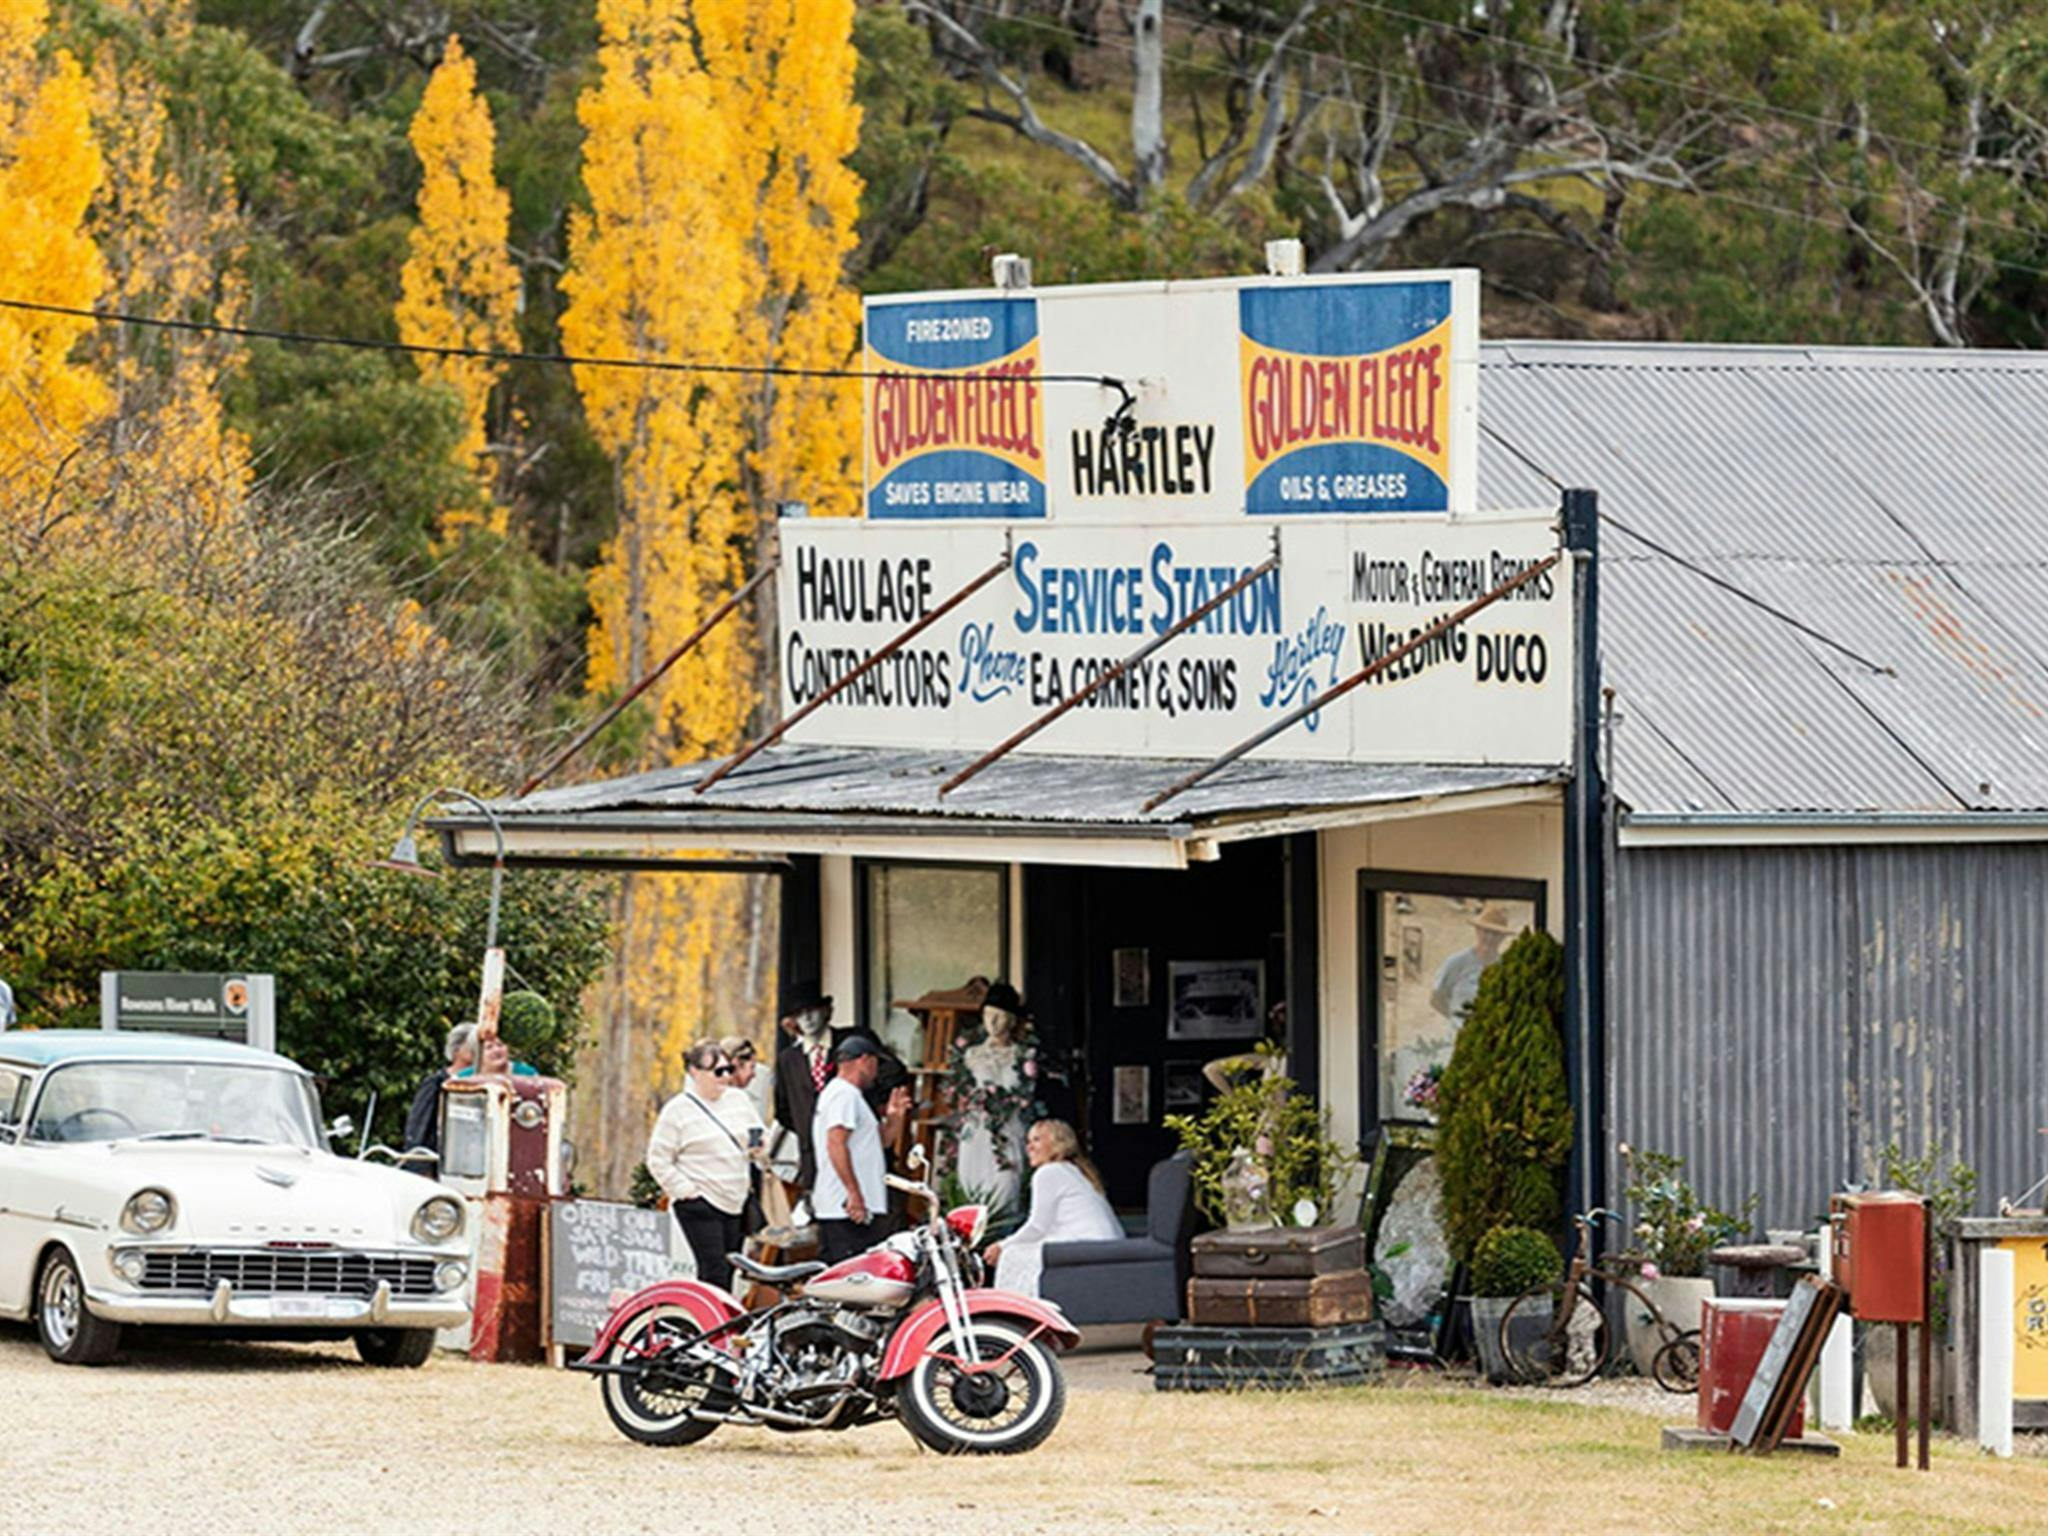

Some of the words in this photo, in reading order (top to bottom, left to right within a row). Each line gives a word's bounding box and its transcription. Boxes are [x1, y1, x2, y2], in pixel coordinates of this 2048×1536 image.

[906, 317, 993, 342] FIREZONED
[874, 370, 960, 467] GOLDEN
[963, 358, 1041, 460] FLEECE
[1250, 356, 1350, 460] GOLDEN
[1358, 344, 1442, 455] FLEECE
[885, 482, 931, 506] SAVES
[934, 481, 984, 505] ENGINE
[986, 480, 1030, 503] WEAR
[1072, 424, 1215, 496] HARTLEY
[1280, 475, 1313, 500] OILS
[1317, 474, 1333, 501] &
[1332, 472, 1408, 500] GREASES
[796, 545, 933, 623] HAULAGE
[1013, 541, 1144, 634] SERVICE
[1149, 542, 1282, 636] STATION
[1353, 551, 1409, 602] MOTOR
[1421, 550, 1486, 602] GENERAL
[1490, 550, 1554, 601] REPAIRS
[787, 629, 951, 708] CONTRACTORS
[958, 622, 1026, 703] Phone
[1259, 606, 1345, 707] Hartley
[1358, 612, 1467, 685] WELDING
[1477, 633, 1547, 684] DUCO
[1070, 657, 1153, 709] CORNEY
[1156, 660, 1176, 718] &
[1177, 658, 1238, 711] SONS
